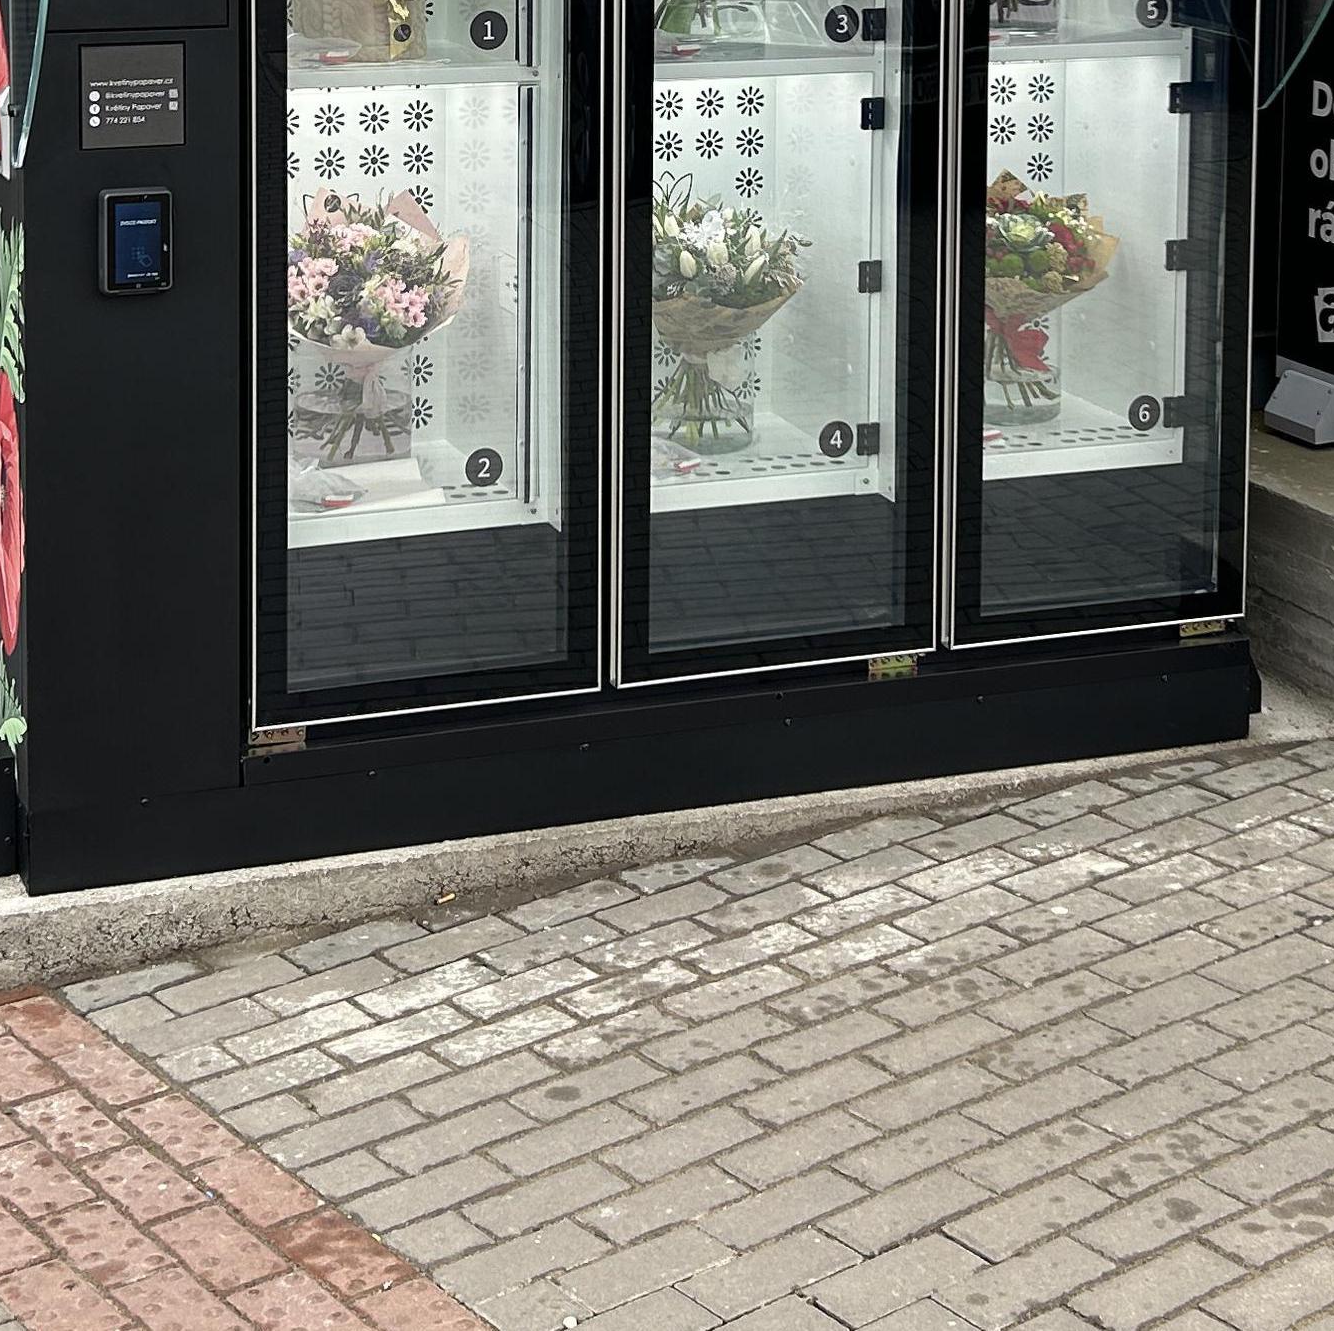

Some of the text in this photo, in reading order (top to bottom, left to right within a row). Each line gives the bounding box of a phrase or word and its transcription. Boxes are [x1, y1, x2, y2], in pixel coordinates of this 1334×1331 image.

[1146, 0, 1159, 20] 5
[482, 20, 495, 41] 1
[836, 14, 849, 34] 3
[1138, 403, 1150, 423] 6
[829, 429, 843, 449] 4
[477, 457, 491, 478] 2
